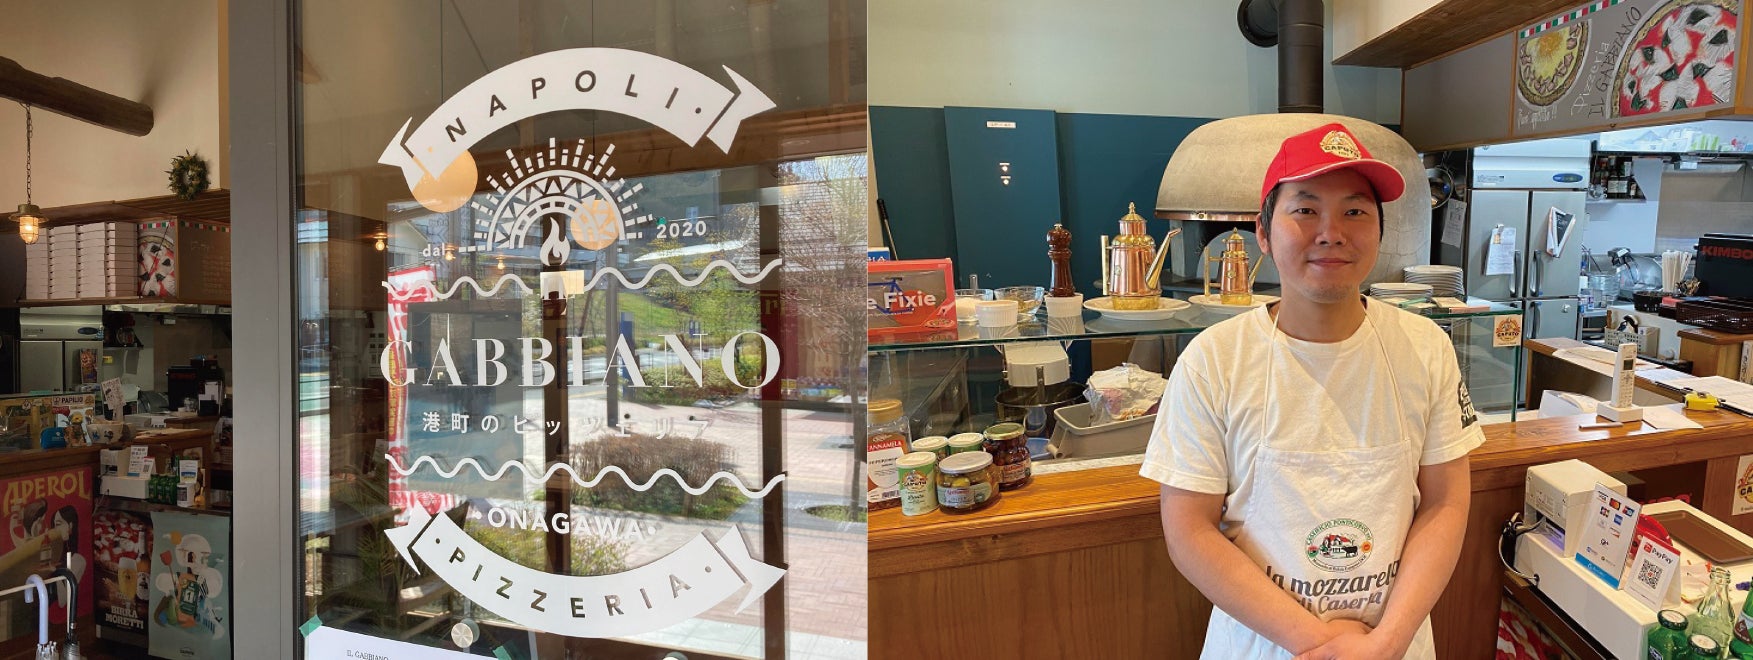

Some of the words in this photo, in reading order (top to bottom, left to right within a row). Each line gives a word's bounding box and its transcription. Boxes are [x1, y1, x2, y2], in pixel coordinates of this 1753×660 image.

[444, 69, 680, 143] NAPOLI
[656, 219, 707, 240] 2020
[421, 242, 445, 258] dal
[1702, 245, 1753, 261] KIMBO
[884, 290, 937, 309] Fixie
[380, 331, 782, 390] GABBIANO
[868, 440, 903, 451] ANNAMELA
[3, 470, 91, 518] APEROL
[487, 507, 643, 540] ONAGAWA
[1651, 547, 1674, 565] PayPay
[448, 546, 692, 619] PIZZERIA
[105, 613, 144, 630] MORETTI
[111, 605, 138, 620] BIRRA
